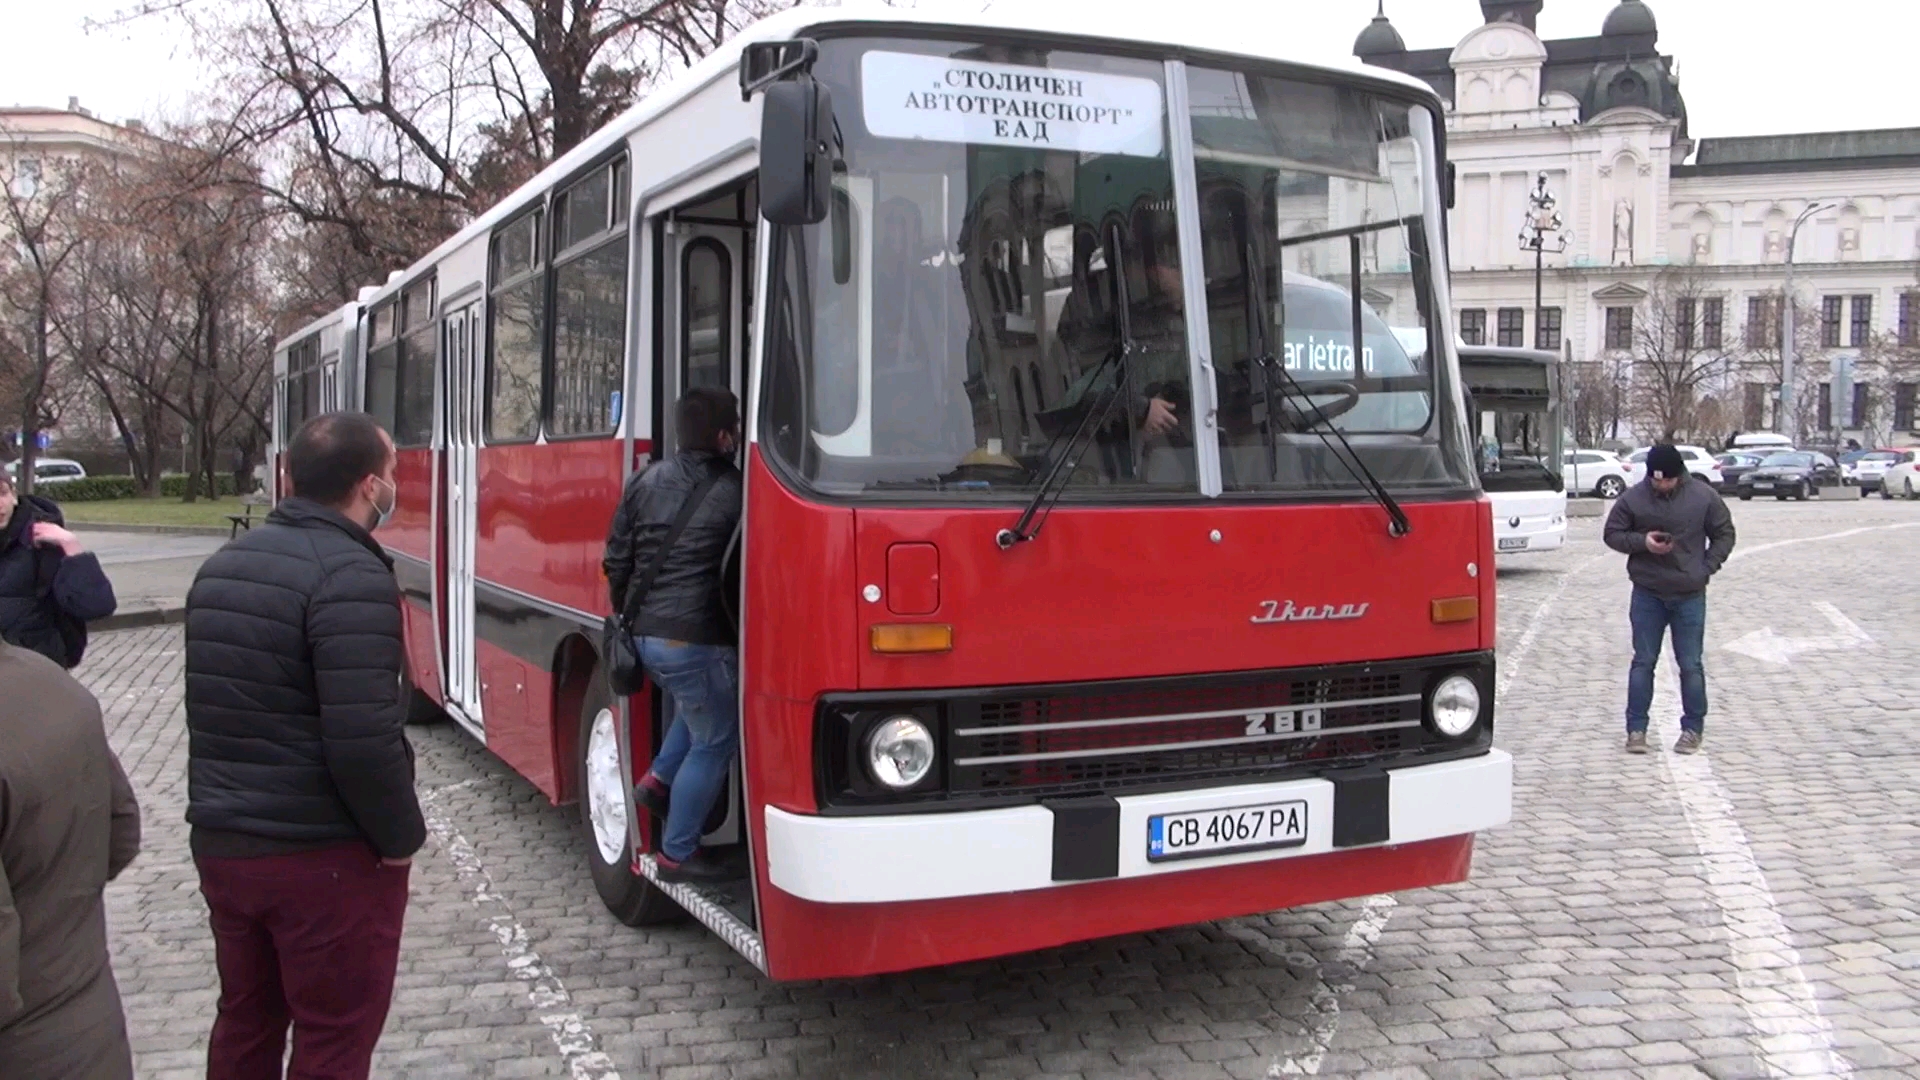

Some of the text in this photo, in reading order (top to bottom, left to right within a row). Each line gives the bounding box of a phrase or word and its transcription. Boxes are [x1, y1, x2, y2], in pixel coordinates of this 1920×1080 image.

[994, 119, 1050, 143] ЕАД
[1250, 599, 1370, 624] Ikarus
[1168, 807, 1300, 848] CB 4067 PA
